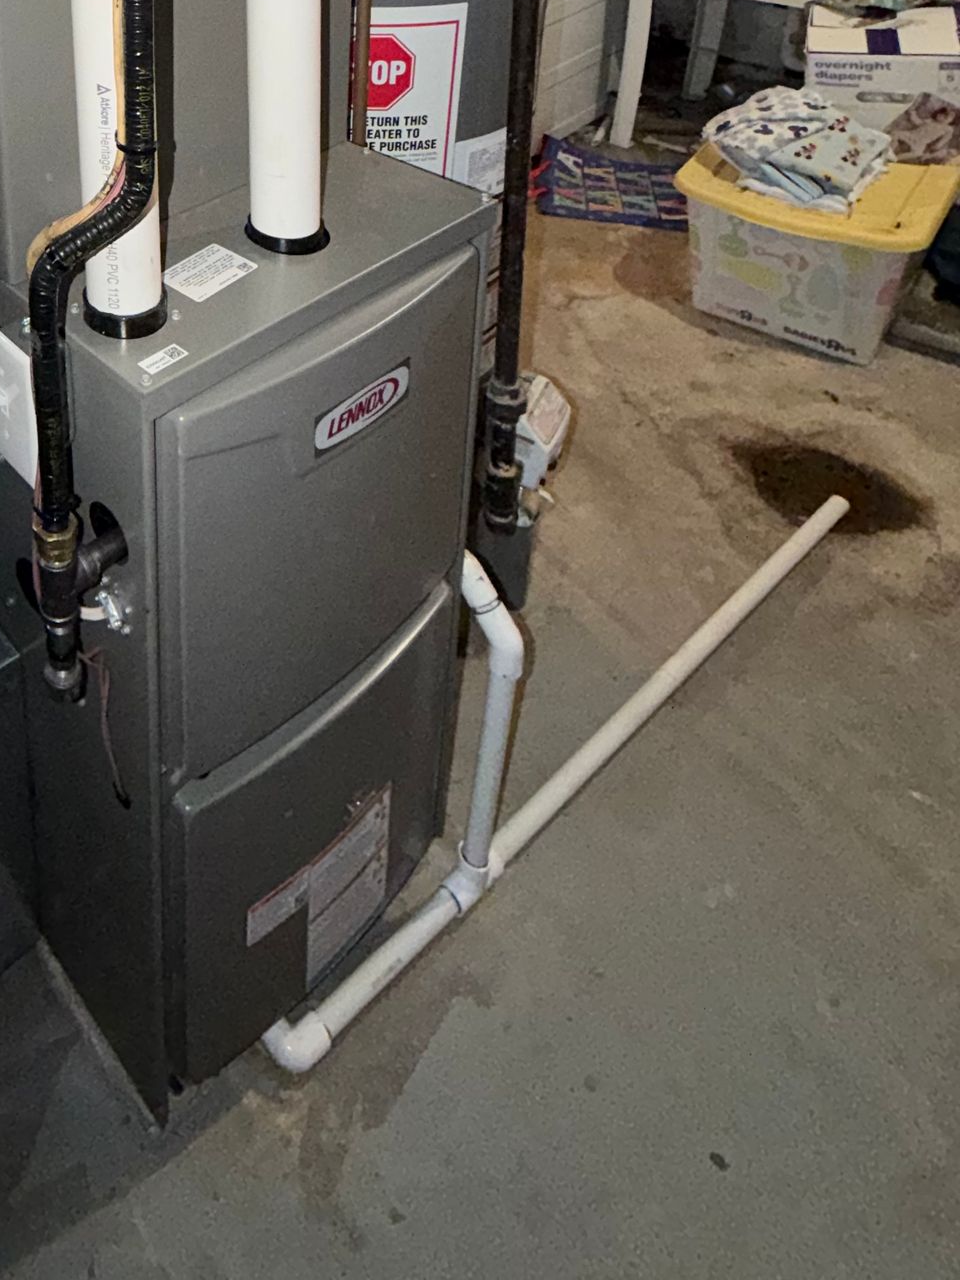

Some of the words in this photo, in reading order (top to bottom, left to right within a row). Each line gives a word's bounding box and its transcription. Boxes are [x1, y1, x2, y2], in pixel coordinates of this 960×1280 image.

[368, 60, 406, 85] OP
[814, 60, 892, 72] overnight
[814, 71, 873, 82] diapers
[100, 97, 111, 126] Atkore
[404, 114, 428, 126] THIS
[367, 128, 402, 139] EATER
[406, 128, 420, 139] TO
[99, 132, 111, 171] Heritage
[380, 139, 437, 152] PURCHASE
[106, 264, 119, 283] PVC
[107, 288, 120, 309] 1120
[327, 383, 387, 441] LENNOX
